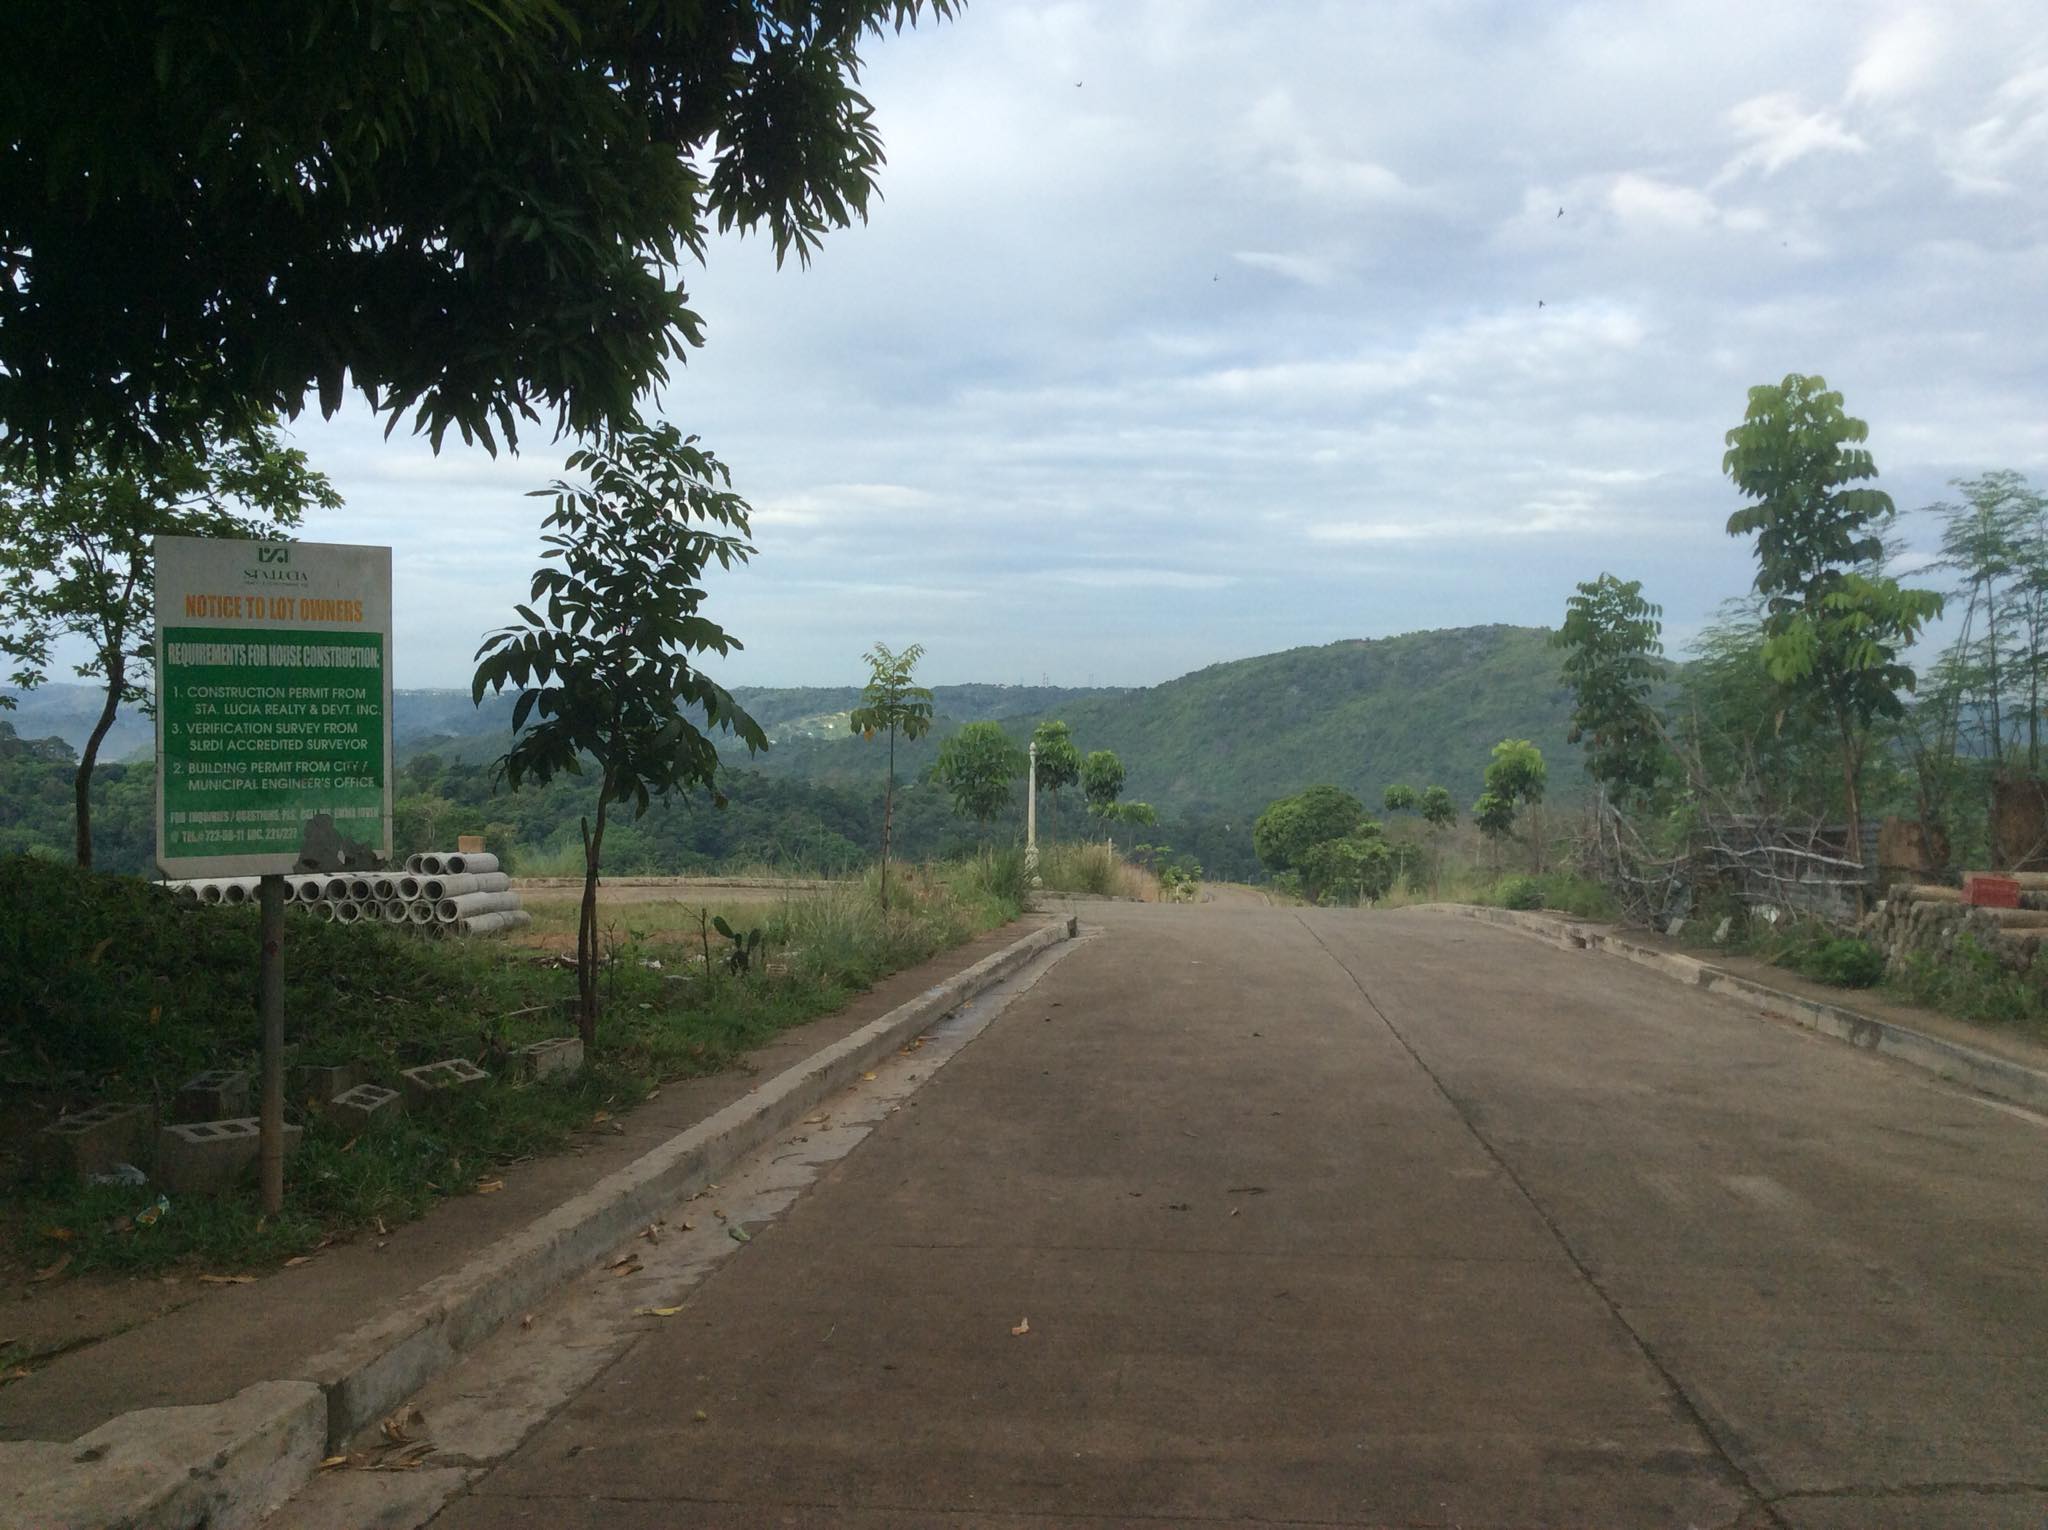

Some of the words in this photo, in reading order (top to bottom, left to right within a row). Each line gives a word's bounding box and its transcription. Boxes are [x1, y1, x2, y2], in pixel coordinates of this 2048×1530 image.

[185, 594, 241, 618] NOTICE
[246, 596, 265, 619] TO
[269, 597, 294, 620] LOT
[301, 599, 363, 623] OWNERS
[168, 642, 247, 667] REQUIREMENTS
[248, 644, 268, 666] FOR
[269, 645, 302, 667] HOUSE
[187, 686, 285, 698] CONSTRUCTION
[289, 687, 329, 699] PERMIT
[332, 688, 366, 699] FROM
[224, 704, 262, 715] LUCIA
[265, 704, 306, 715] REALTY
[310, 704, 318, 715] &
[172, 723, 182, 734] 3.
[186, 723, 272, 734] VERIFICATION
[275, 723, 320, 733] SURVEY
[323, 722, 358, 733] FROM
[227, 739, 303, 751] ACCREDITED
[307, 739, 368, 750] SURVEYOR
[173, 763, 184, 774] 2.
[188, 762, 247, 774] BUILDING
[251, 761, 292, 773] PERMIT
[296, 761, 331, 772] FROM
[188, 780, 258, 791] MUNICIPAL
[262, 778, 331, 789] ENGINEER'S
